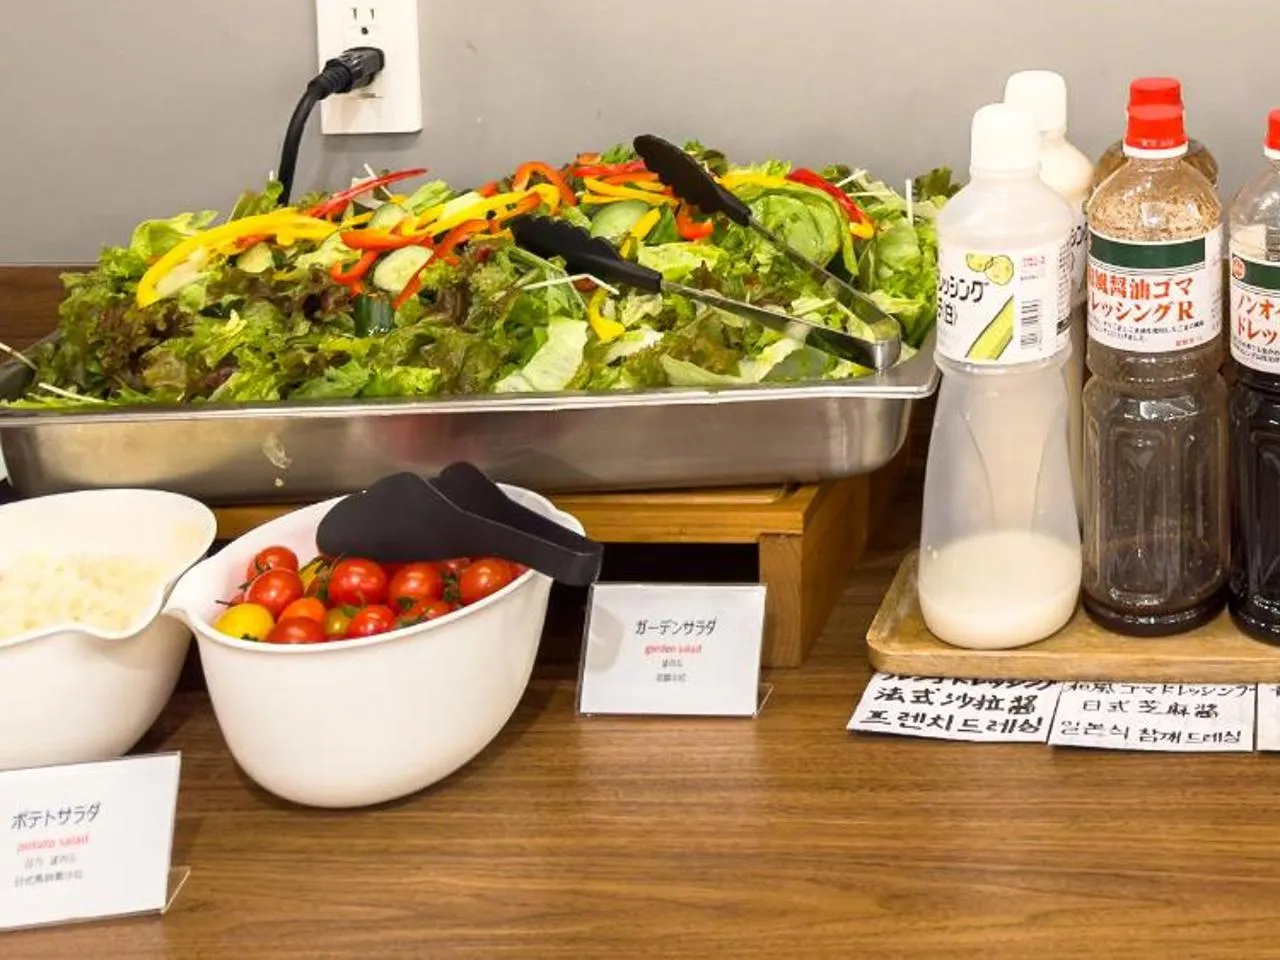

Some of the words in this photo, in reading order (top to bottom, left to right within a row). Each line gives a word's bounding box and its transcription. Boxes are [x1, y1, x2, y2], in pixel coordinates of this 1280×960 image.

[635, 617, 717, 635] ガーデンサラダ
[11, 802, 101, 829] ポテトサラダ
